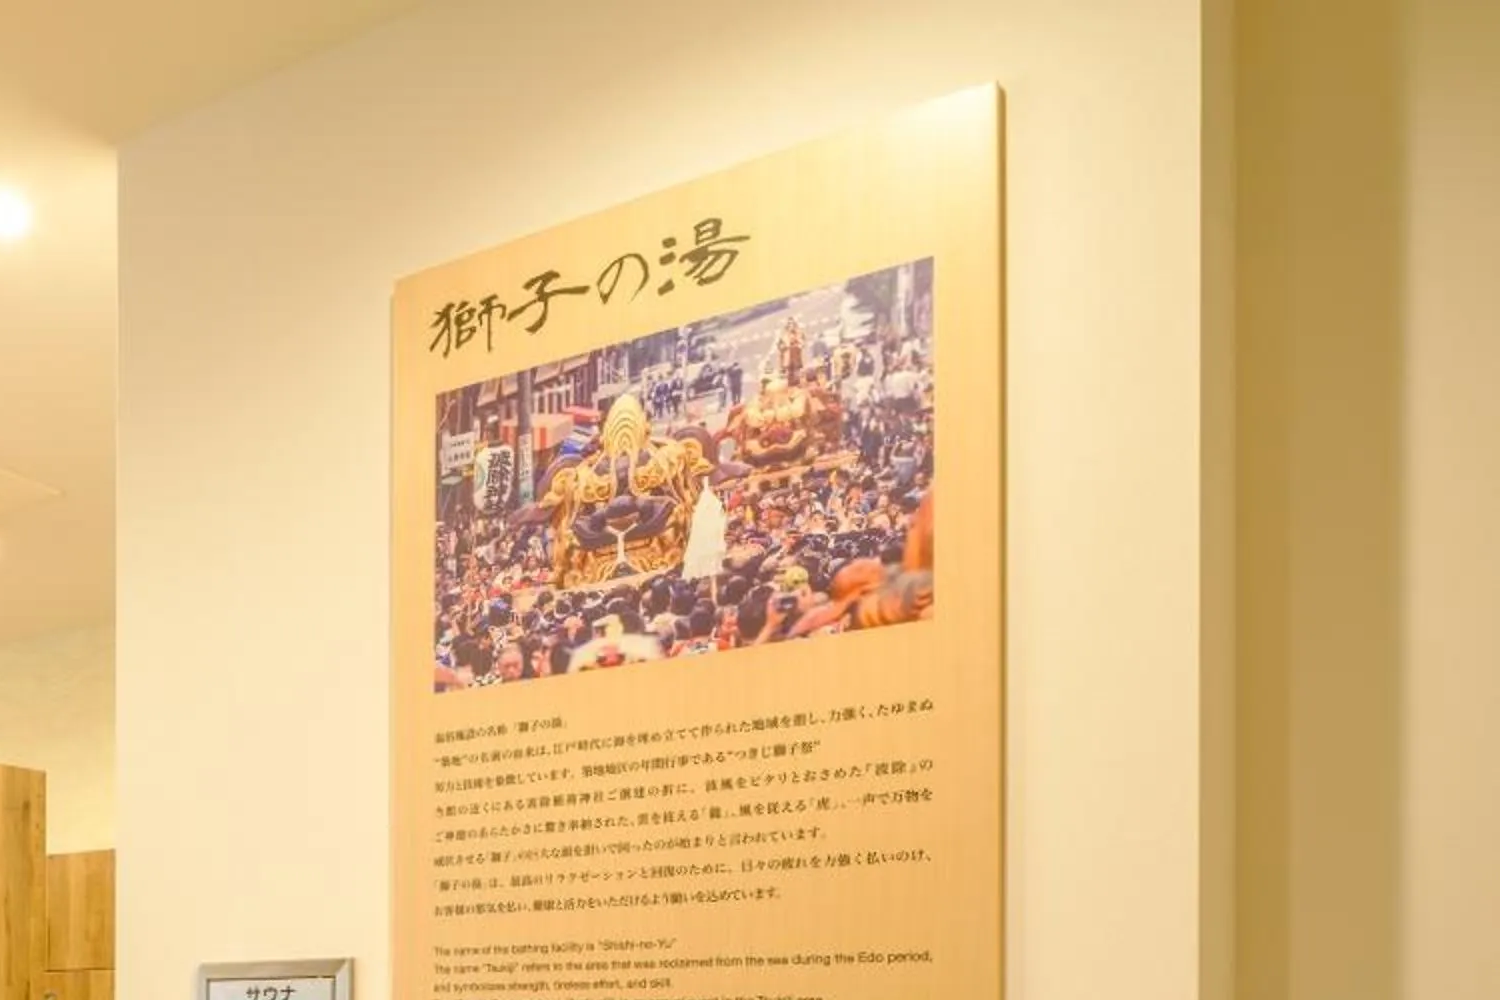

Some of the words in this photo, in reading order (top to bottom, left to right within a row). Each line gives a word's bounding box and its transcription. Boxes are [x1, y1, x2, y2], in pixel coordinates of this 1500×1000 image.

[429, 217, 751, 359] 獅子の湯
[657, 954, 714, 969] reclaimed
[714, 953, 743, 968] from
[744, 953, 765, 967] the
[766, 954, 789, 966] sea
[790, 951, 831, 969] during
[833, 950, 855, 965] the
[856, 949, 884, 964] Edo
[886, 947, 932, 966] period,
[648, 975, 674, 989] skill.
